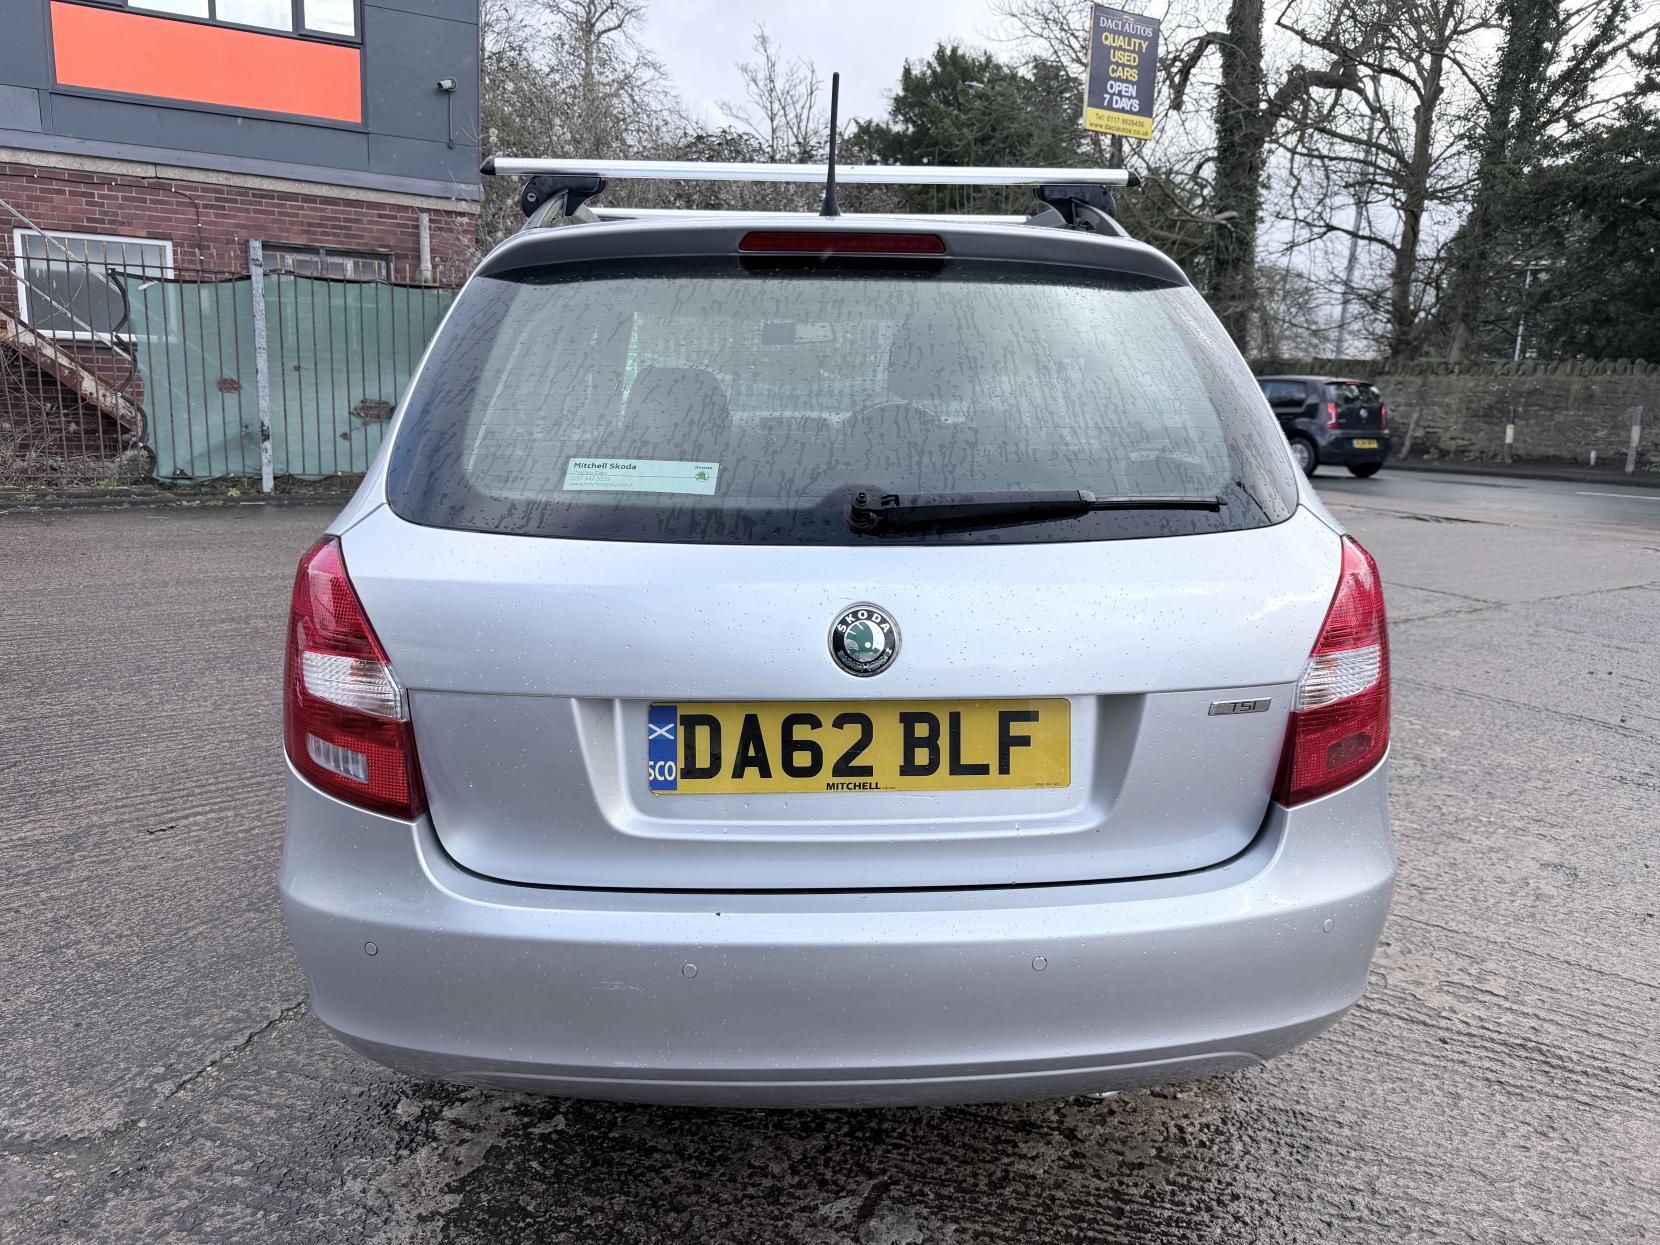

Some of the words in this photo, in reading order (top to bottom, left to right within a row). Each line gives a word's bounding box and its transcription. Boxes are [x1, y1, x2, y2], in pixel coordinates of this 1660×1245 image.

[1100, 16, 1122, 31] DACI
[1123, 22, 1153, 38] AUTOS
[1102, 32, 1148, 53] QUALITY
[1110, 49, 1139, 66] USED
[1109, 65, 1138, 81] CARS
[1107, 80, 1137, 97] OPEN
[1103, 94, 1110, 106] 7
[1112, 96, 1139, 112] DAYS
[837, 610, 891, 633] SKODA
[1230, 701, 1256, 712] TSI
[680, 713, 874, 779] DA62
[899, 710, 1040, 777] BLF
[649, 760, 676, 781] SCO
[826, 782, 881, 791] MITCHELL
